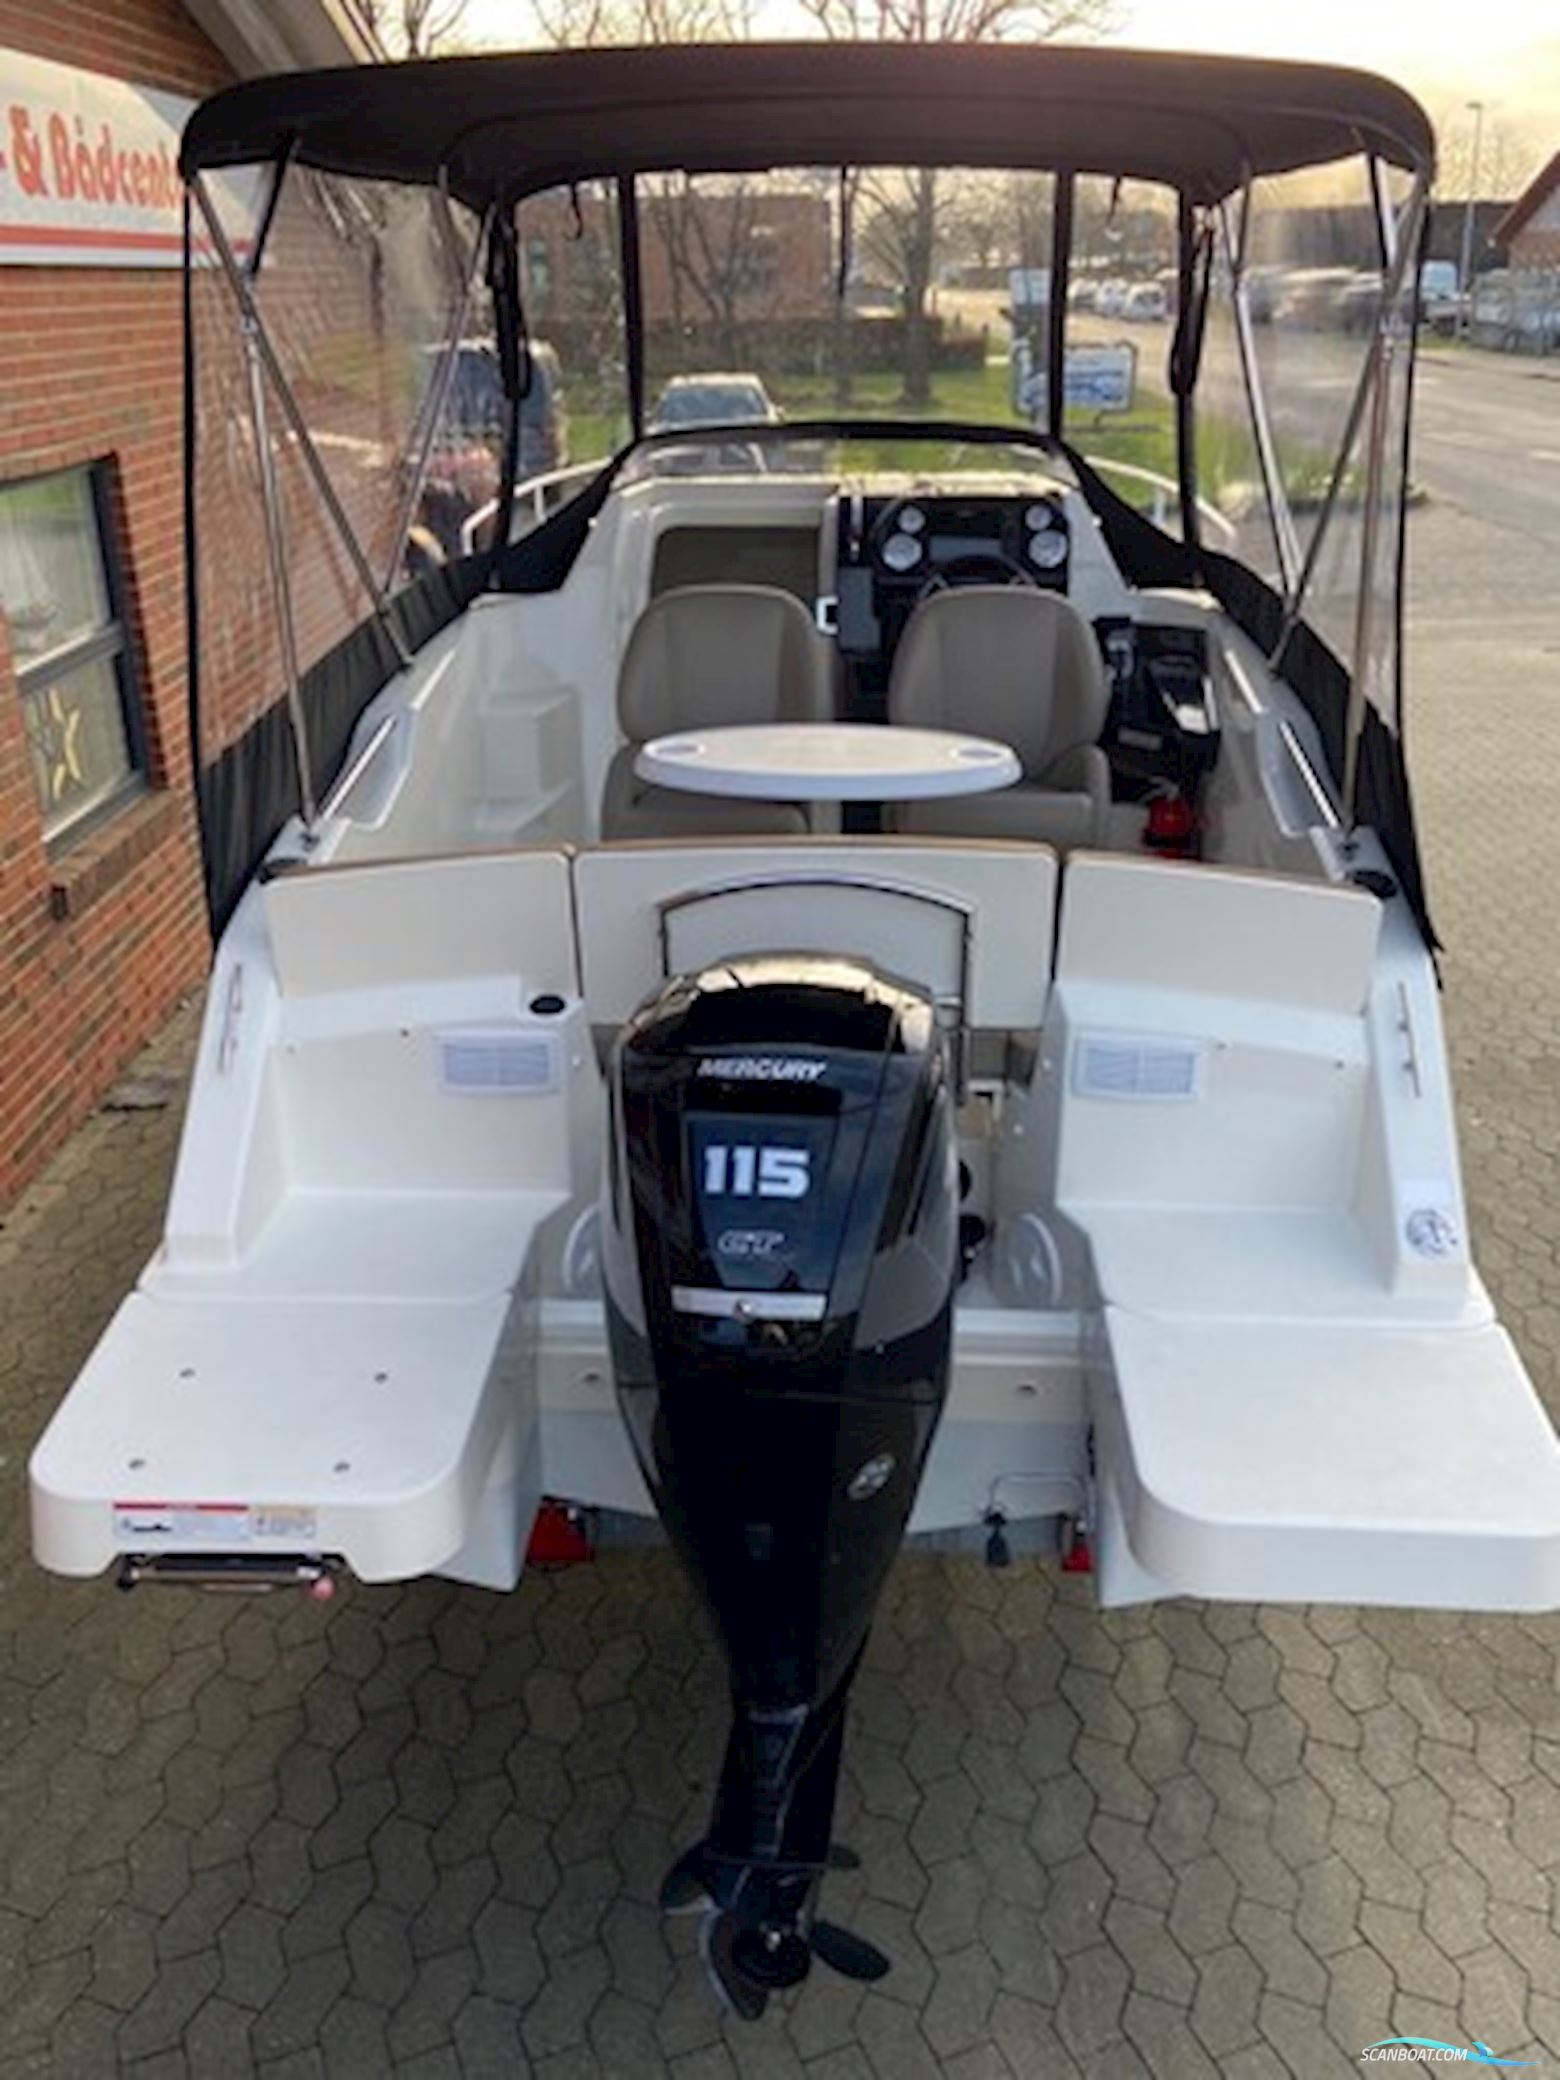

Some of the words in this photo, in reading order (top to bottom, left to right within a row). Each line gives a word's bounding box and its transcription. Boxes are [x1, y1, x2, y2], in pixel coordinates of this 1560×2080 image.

[9, 105, 49, 198] &
[698, 1057, 827, 1080] MERCURY
[705, 1145, 811, 1199] 115
